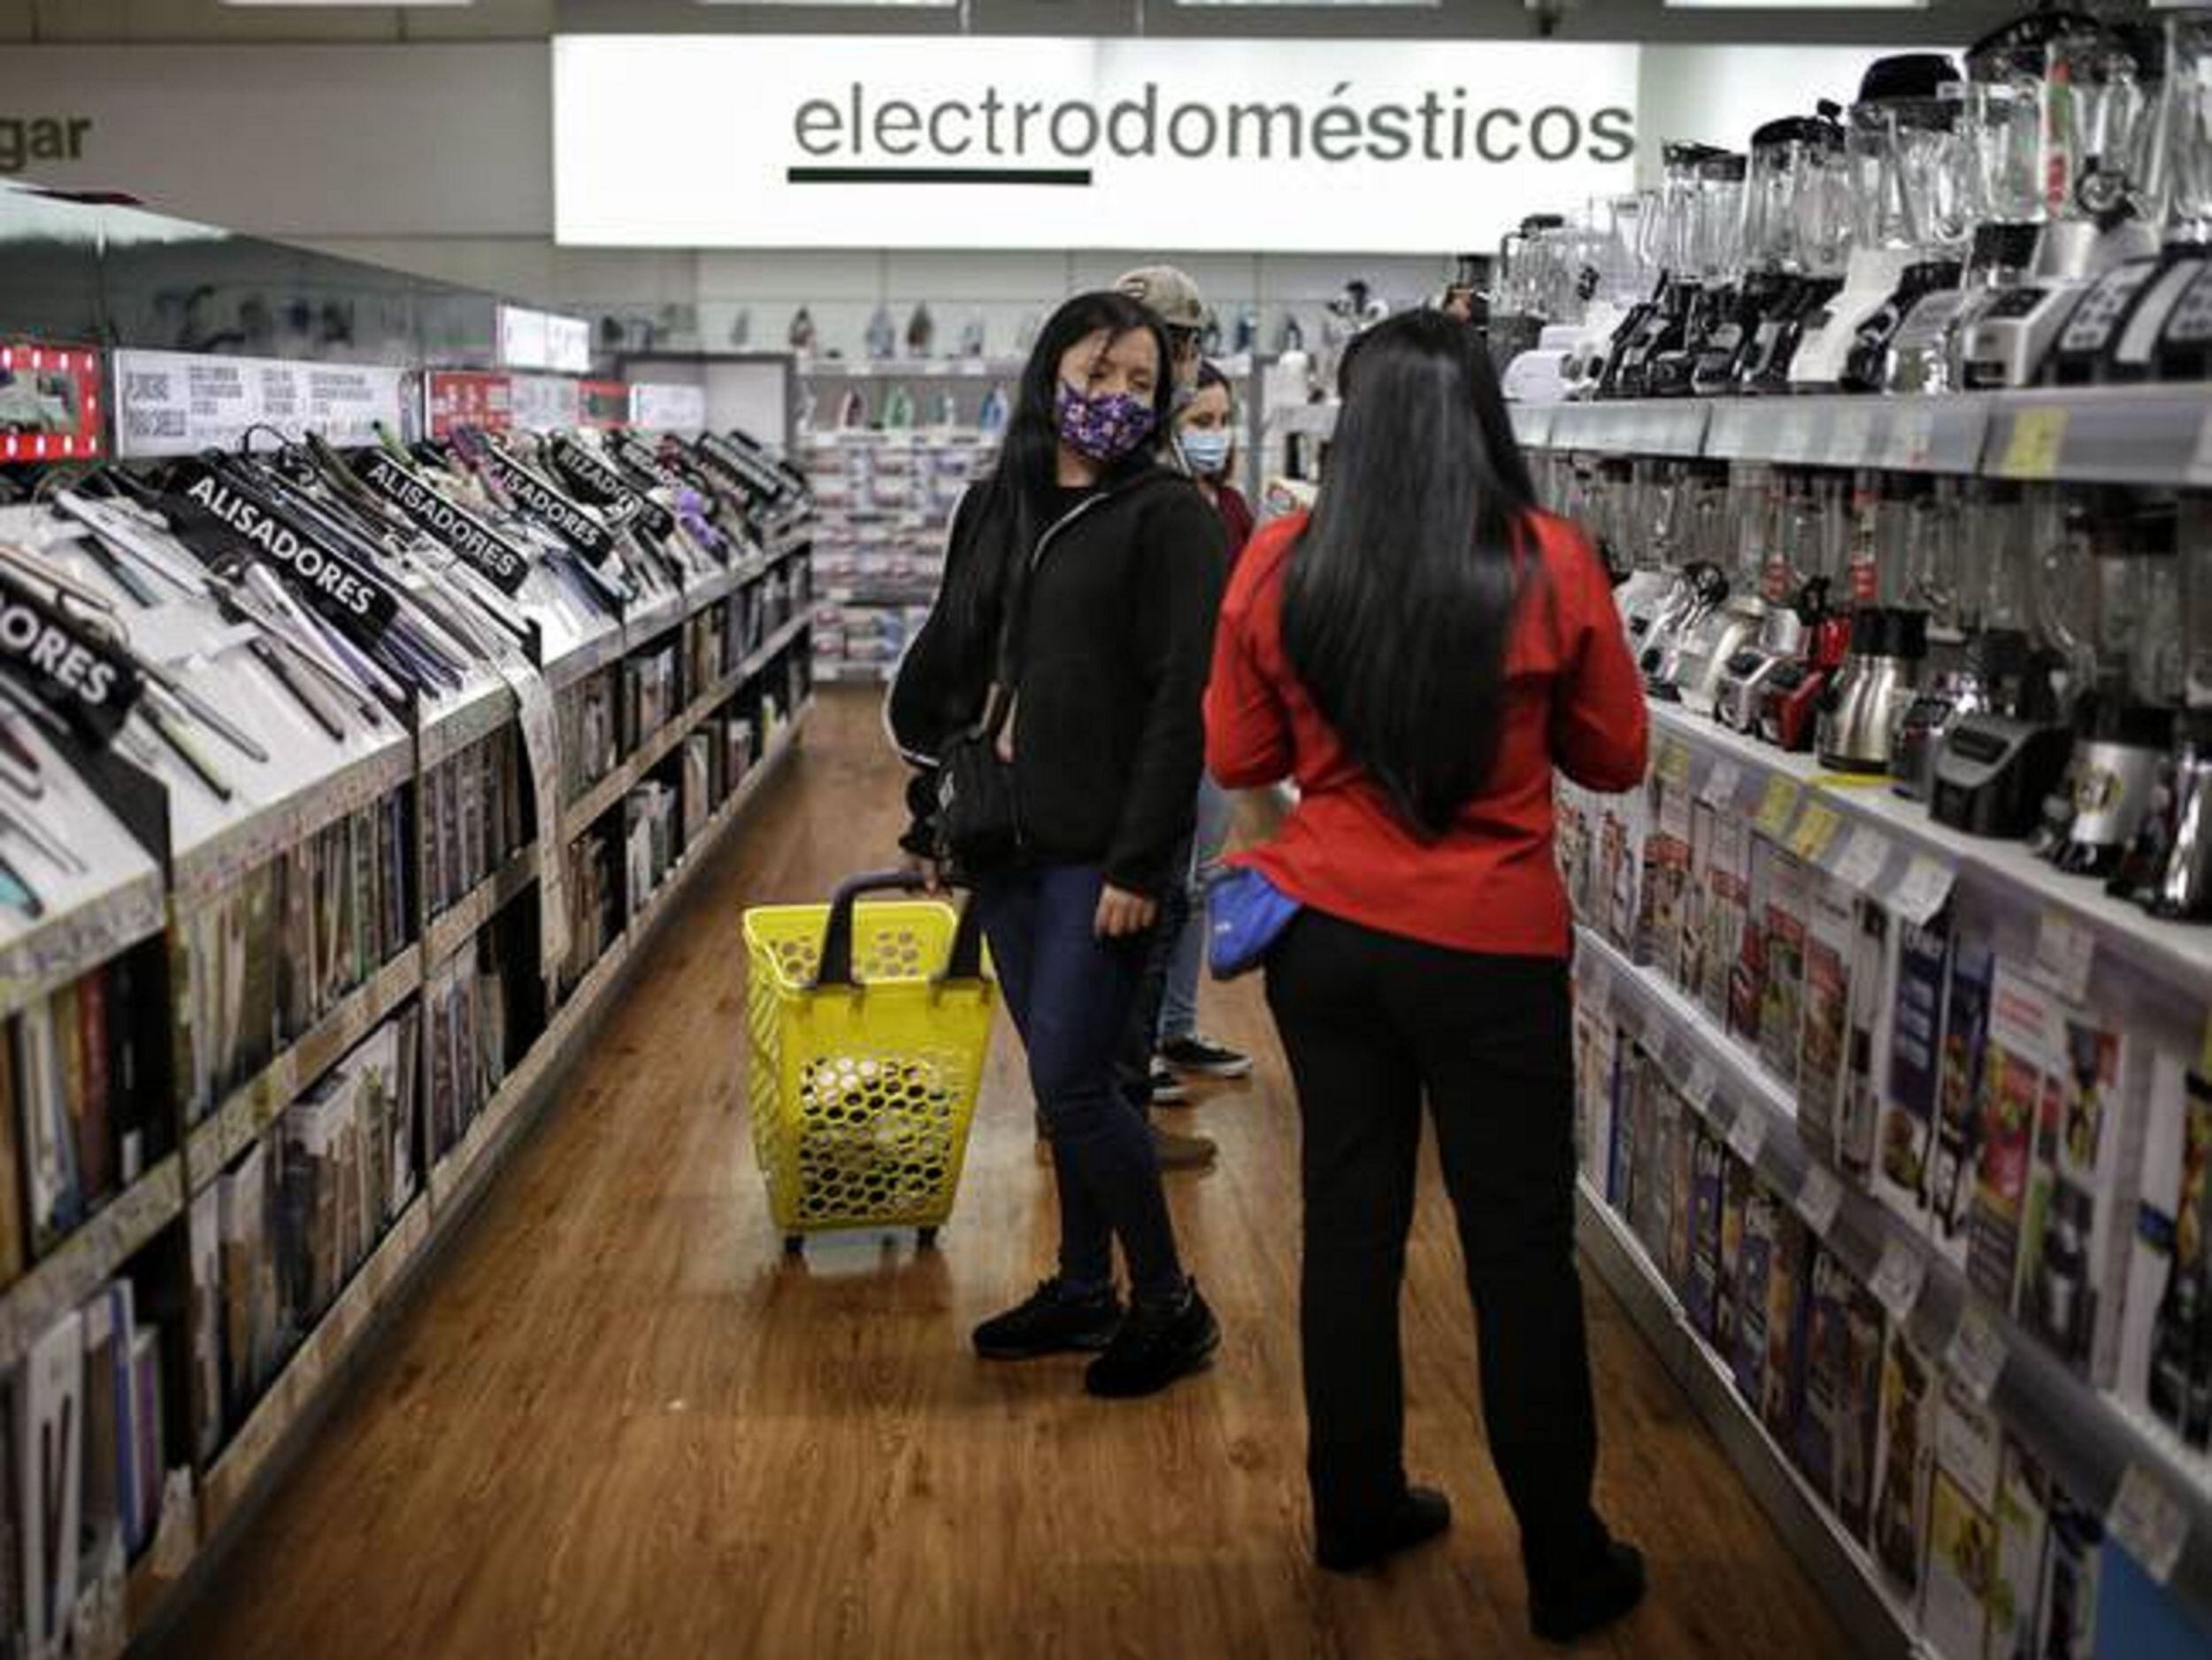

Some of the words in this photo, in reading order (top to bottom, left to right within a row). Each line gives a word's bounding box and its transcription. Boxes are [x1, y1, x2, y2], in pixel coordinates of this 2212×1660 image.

[794, 81, 1636, 163] electrodomésticos
[188, 475, 376, 614] ALISADORES
[367, 463, 518, 576] ALISADORES
[490, 460, 600, 546] ISADORES
[0, 603, 117, 704] ORES
